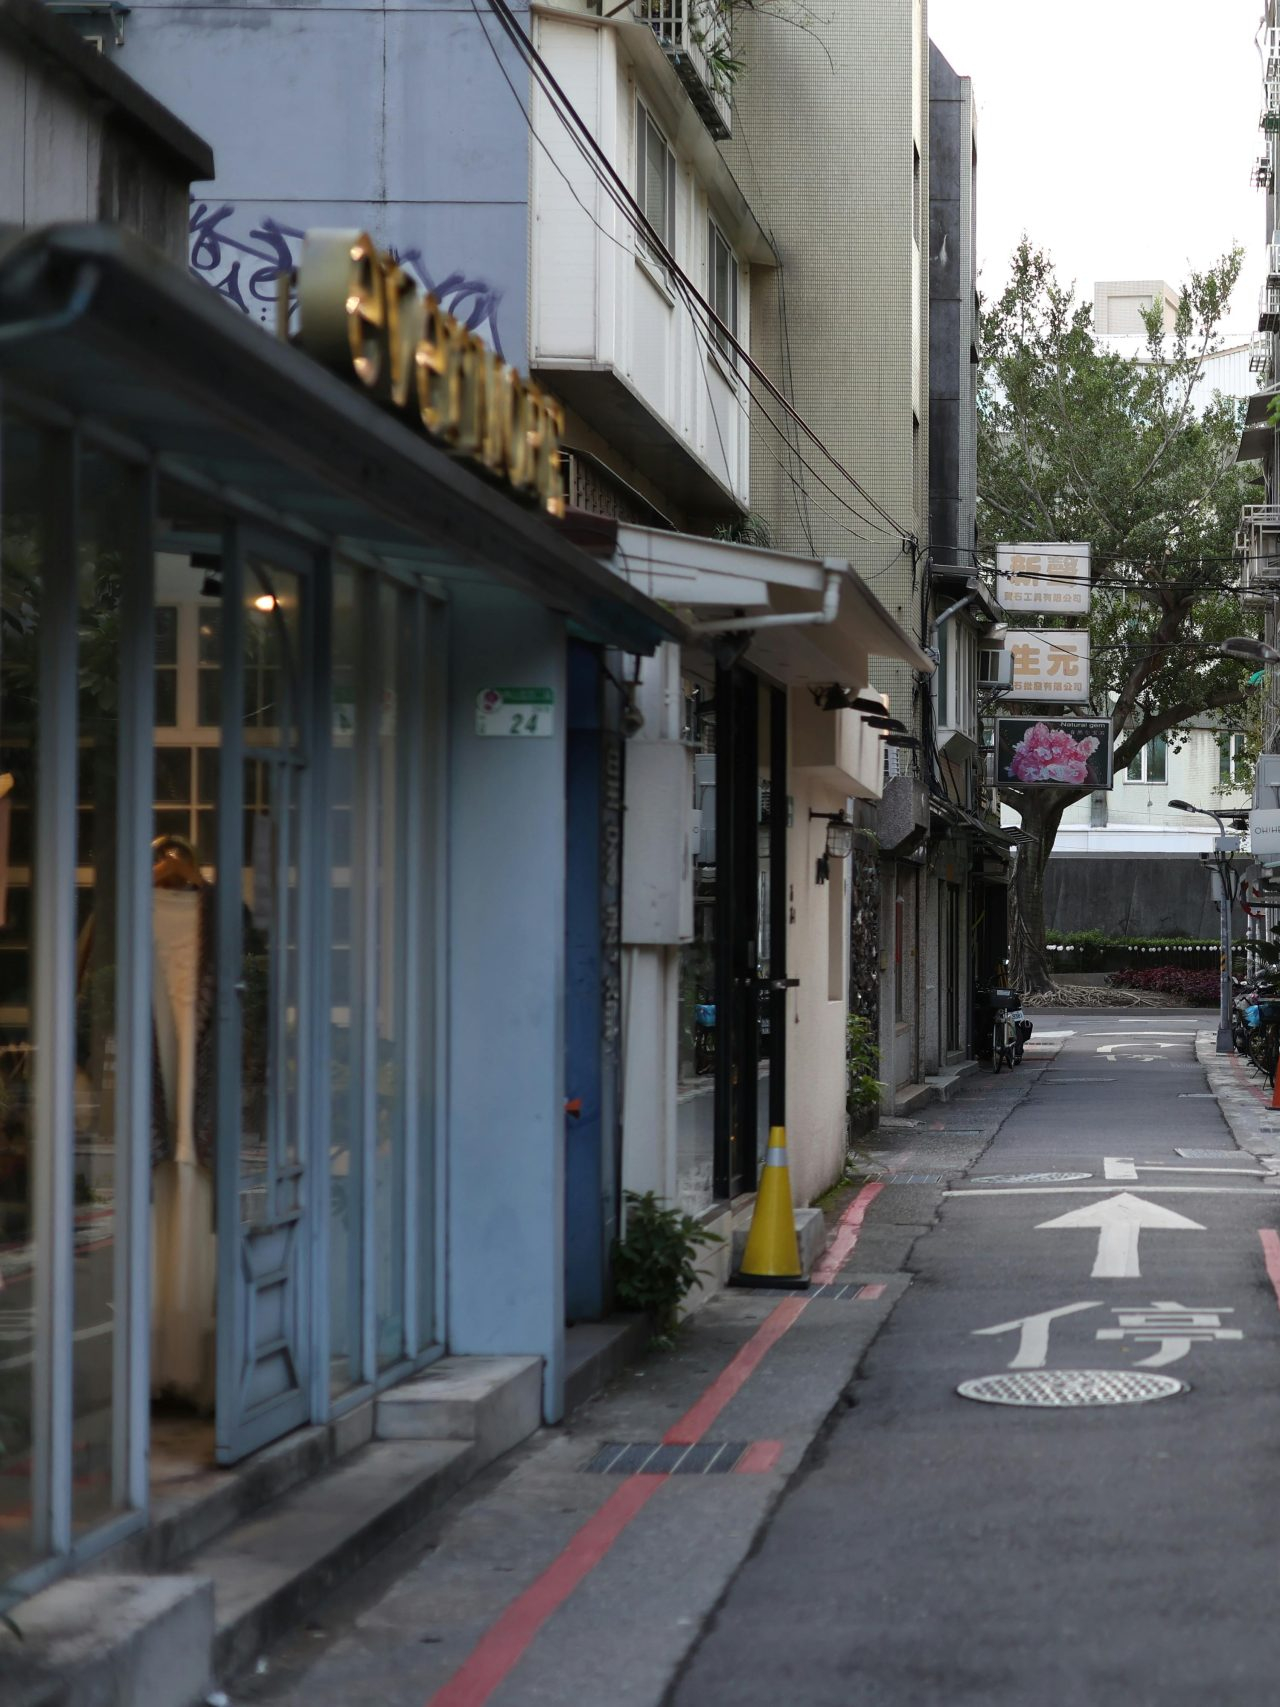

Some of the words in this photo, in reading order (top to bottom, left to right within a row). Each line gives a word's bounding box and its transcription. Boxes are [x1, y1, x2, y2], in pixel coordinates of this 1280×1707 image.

[1012, 643, 1079, 677] 生元
[510, 713, 537, 734] 24
[971, 1301, 1244, 1368] 停
